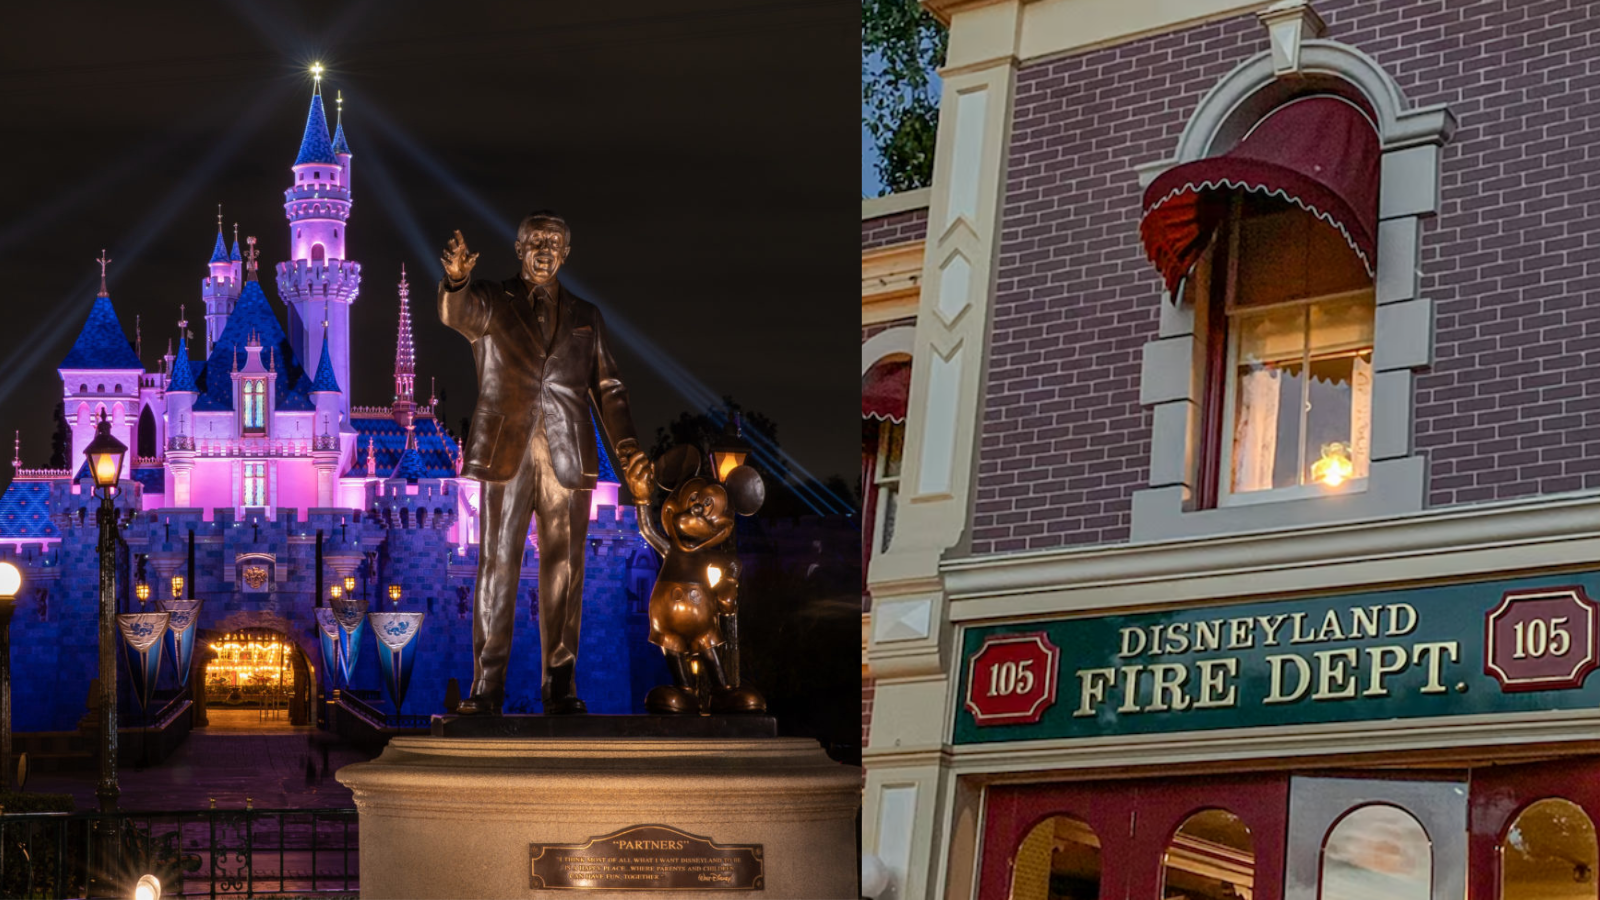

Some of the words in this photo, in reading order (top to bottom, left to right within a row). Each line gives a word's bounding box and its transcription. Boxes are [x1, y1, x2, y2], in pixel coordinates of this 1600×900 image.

[1117, 602, 1418, 659] DISNEYLAND
[1512, 616, 1571, 660] 105
[986, 659, 1034, 697] 105
[1072, 657, 1237, 718] FIRE
[1262, 641, 1467, 704] DEPT.
